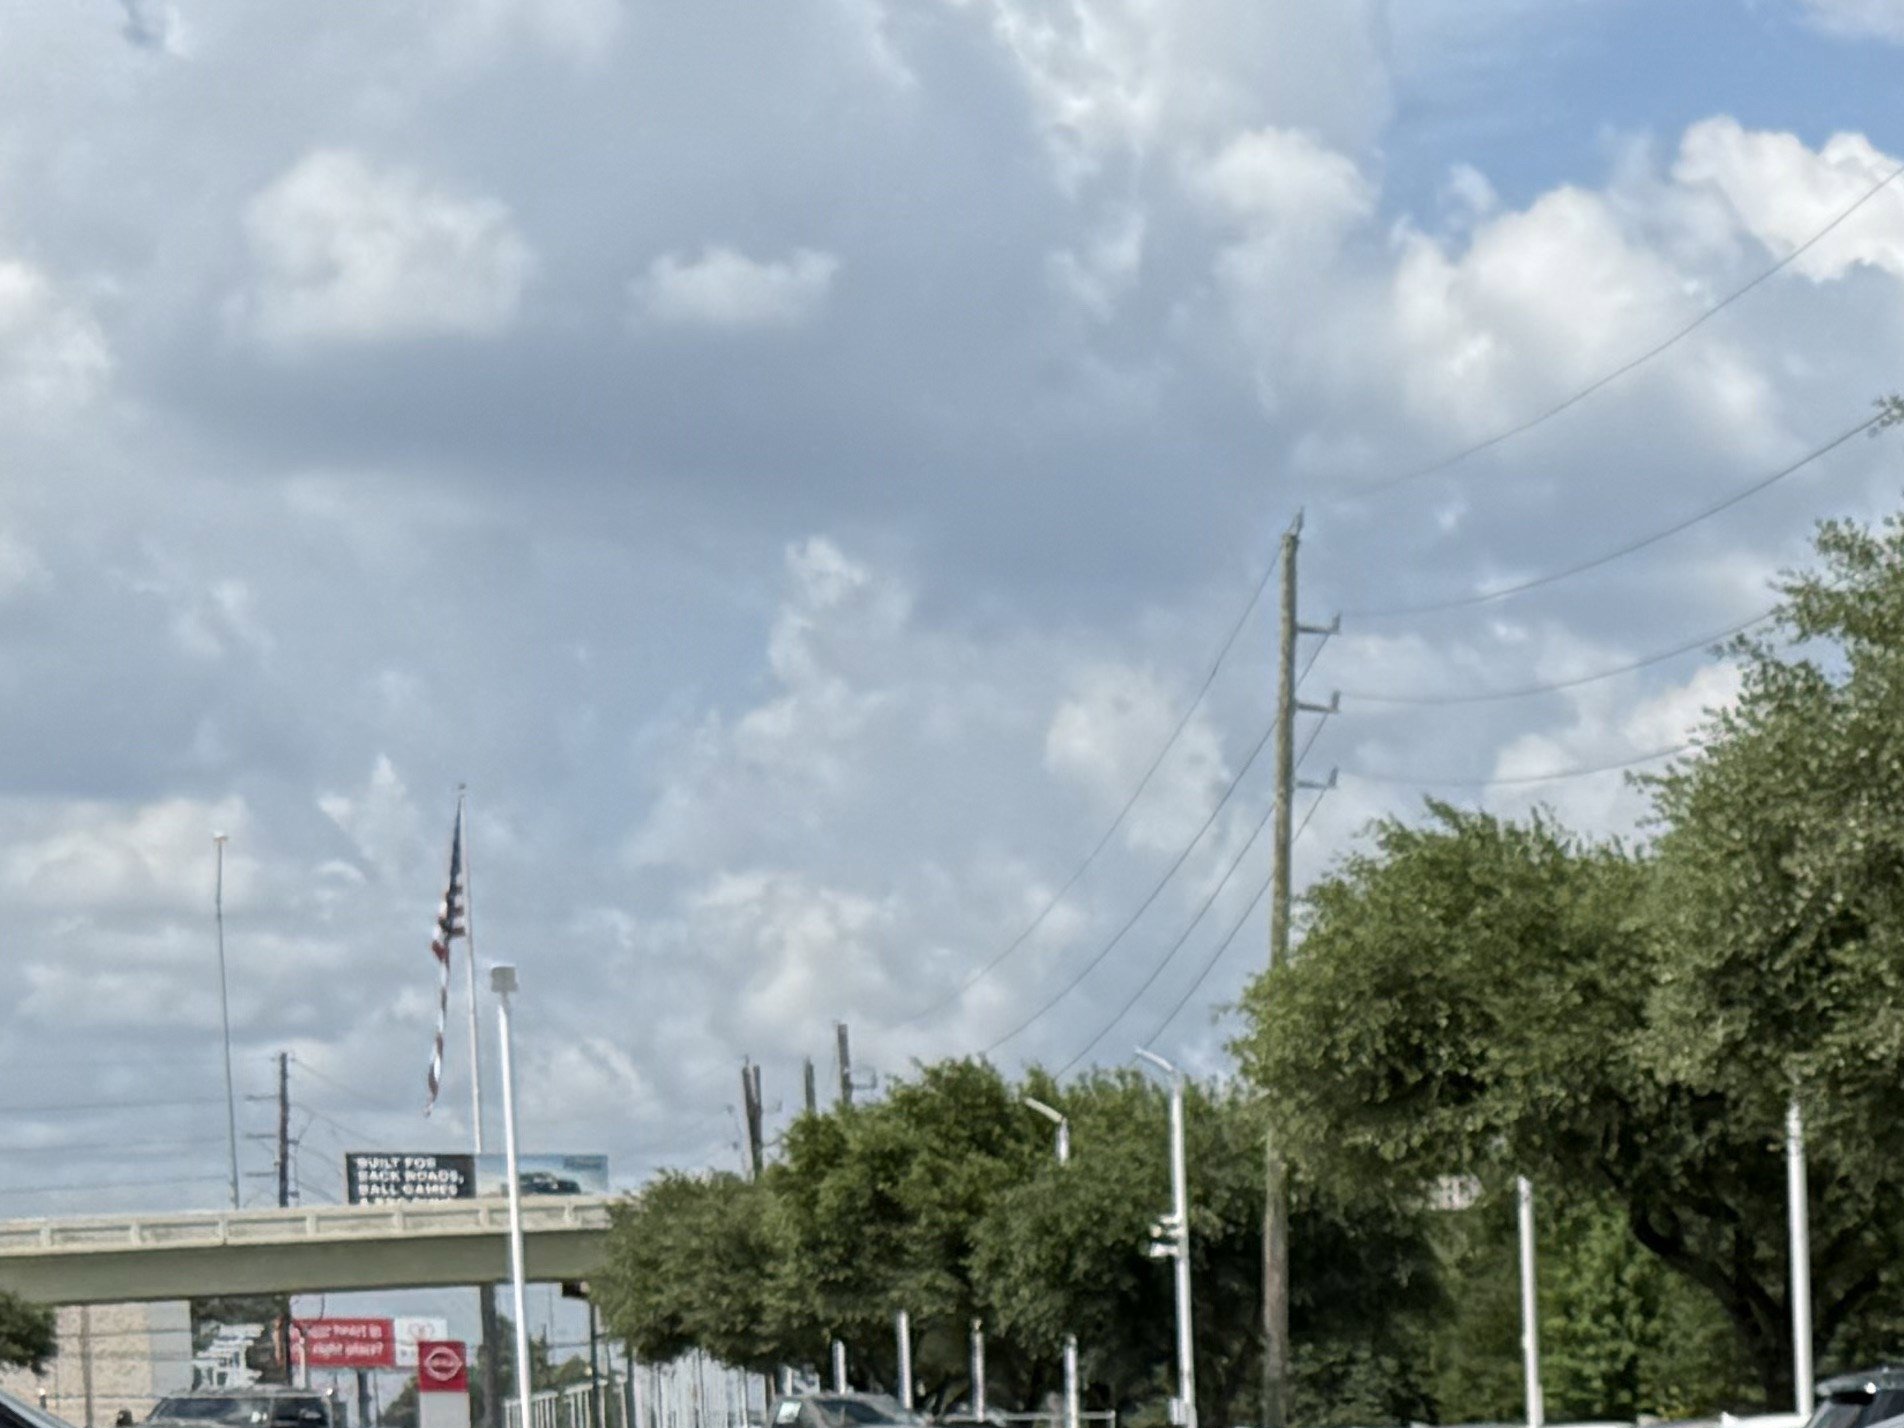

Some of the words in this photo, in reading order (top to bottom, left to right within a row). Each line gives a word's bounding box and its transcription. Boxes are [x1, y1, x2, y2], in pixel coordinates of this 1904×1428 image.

[357, 1157, 400, 1169] BUILT
[404, 1157, 436, 1169] FOR
[358, 1169, 401, 1182] BACK
[358, 1183, 399, 1196] BALL
[402, 1183, 459, 1196] GAMES
